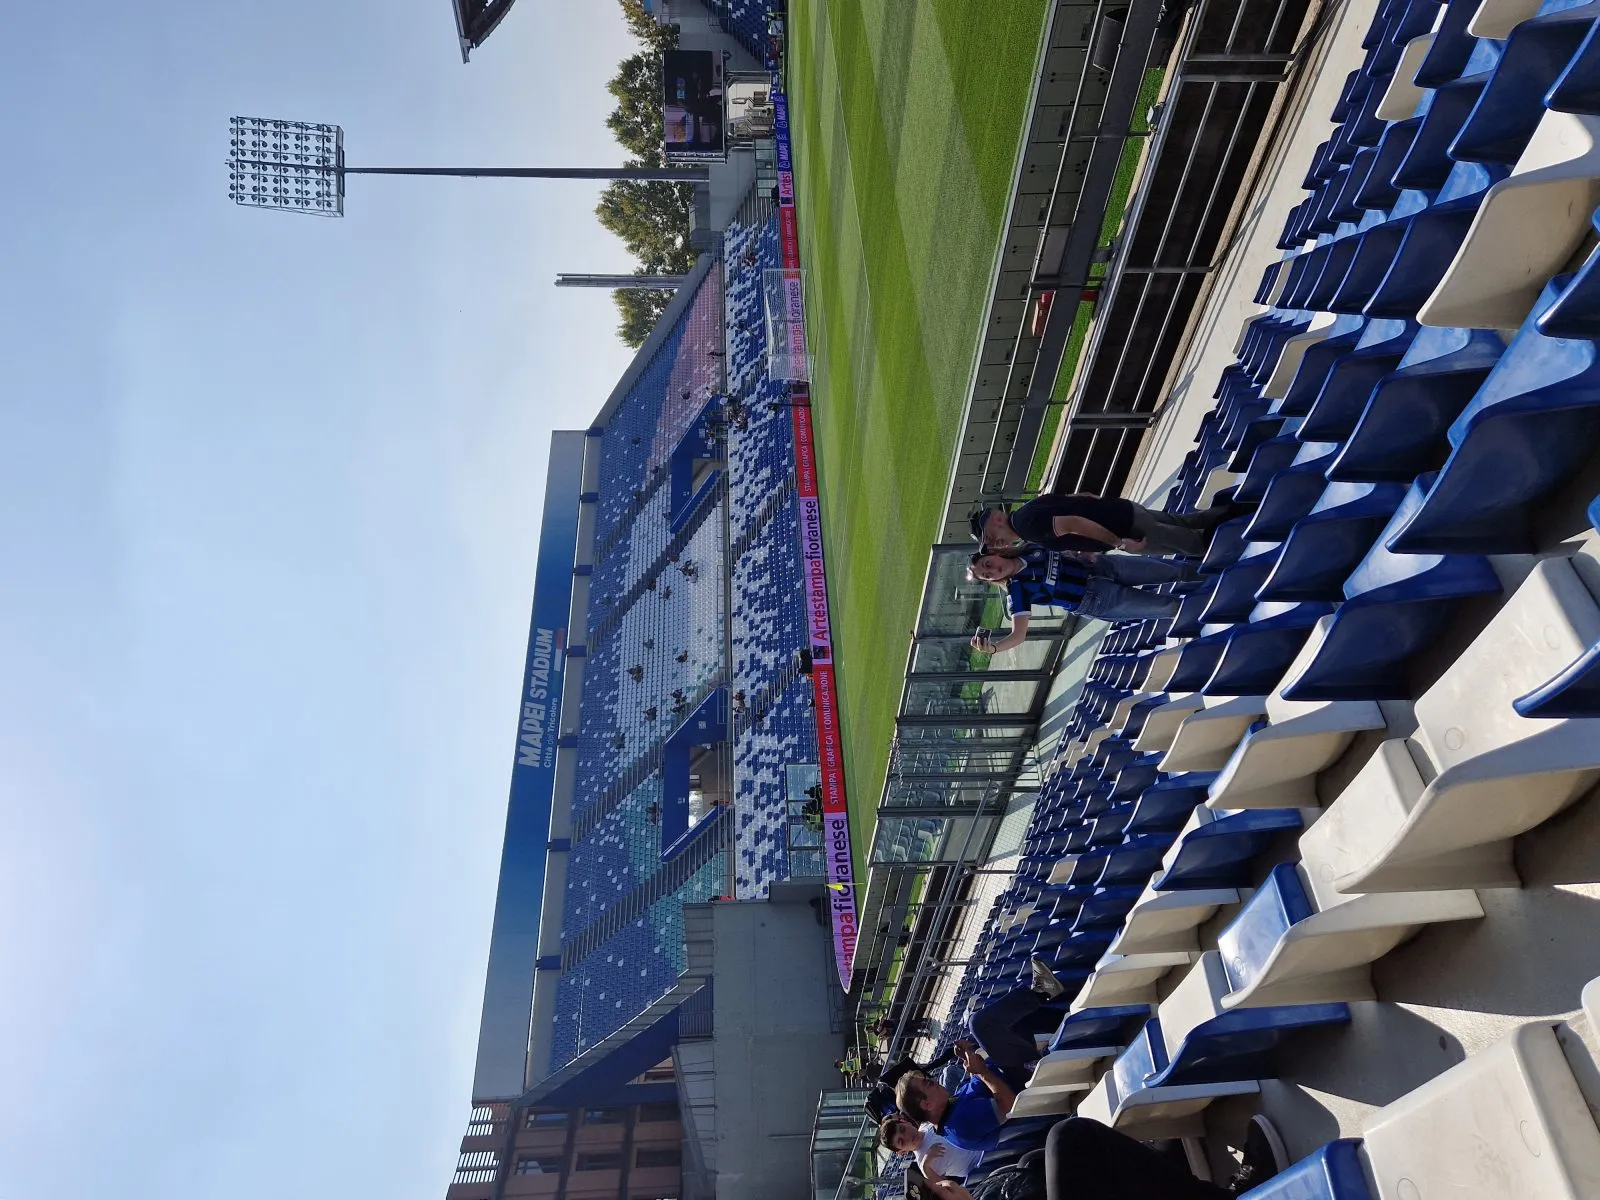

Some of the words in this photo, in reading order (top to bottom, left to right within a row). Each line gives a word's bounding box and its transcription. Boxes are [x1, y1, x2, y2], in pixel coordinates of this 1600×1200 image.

[778, 142, 788, 160] MAPEI
[801, 445, 810, 468] GRAFICA
[804, 470, 812, 492] STAMPA
[804, 500, 828, 641] Artestampafioranese
[530, 628, 553, 699] STADIUM
[547, 698, 558, 732] Tricolore
[820, 671, 832, 730] COMUNICAZIONE
[518, 702, 546, 768] MAPEI
[826, 734, 836, 767] GRAFICA
[830, 772, 839, 805] STAMPA
